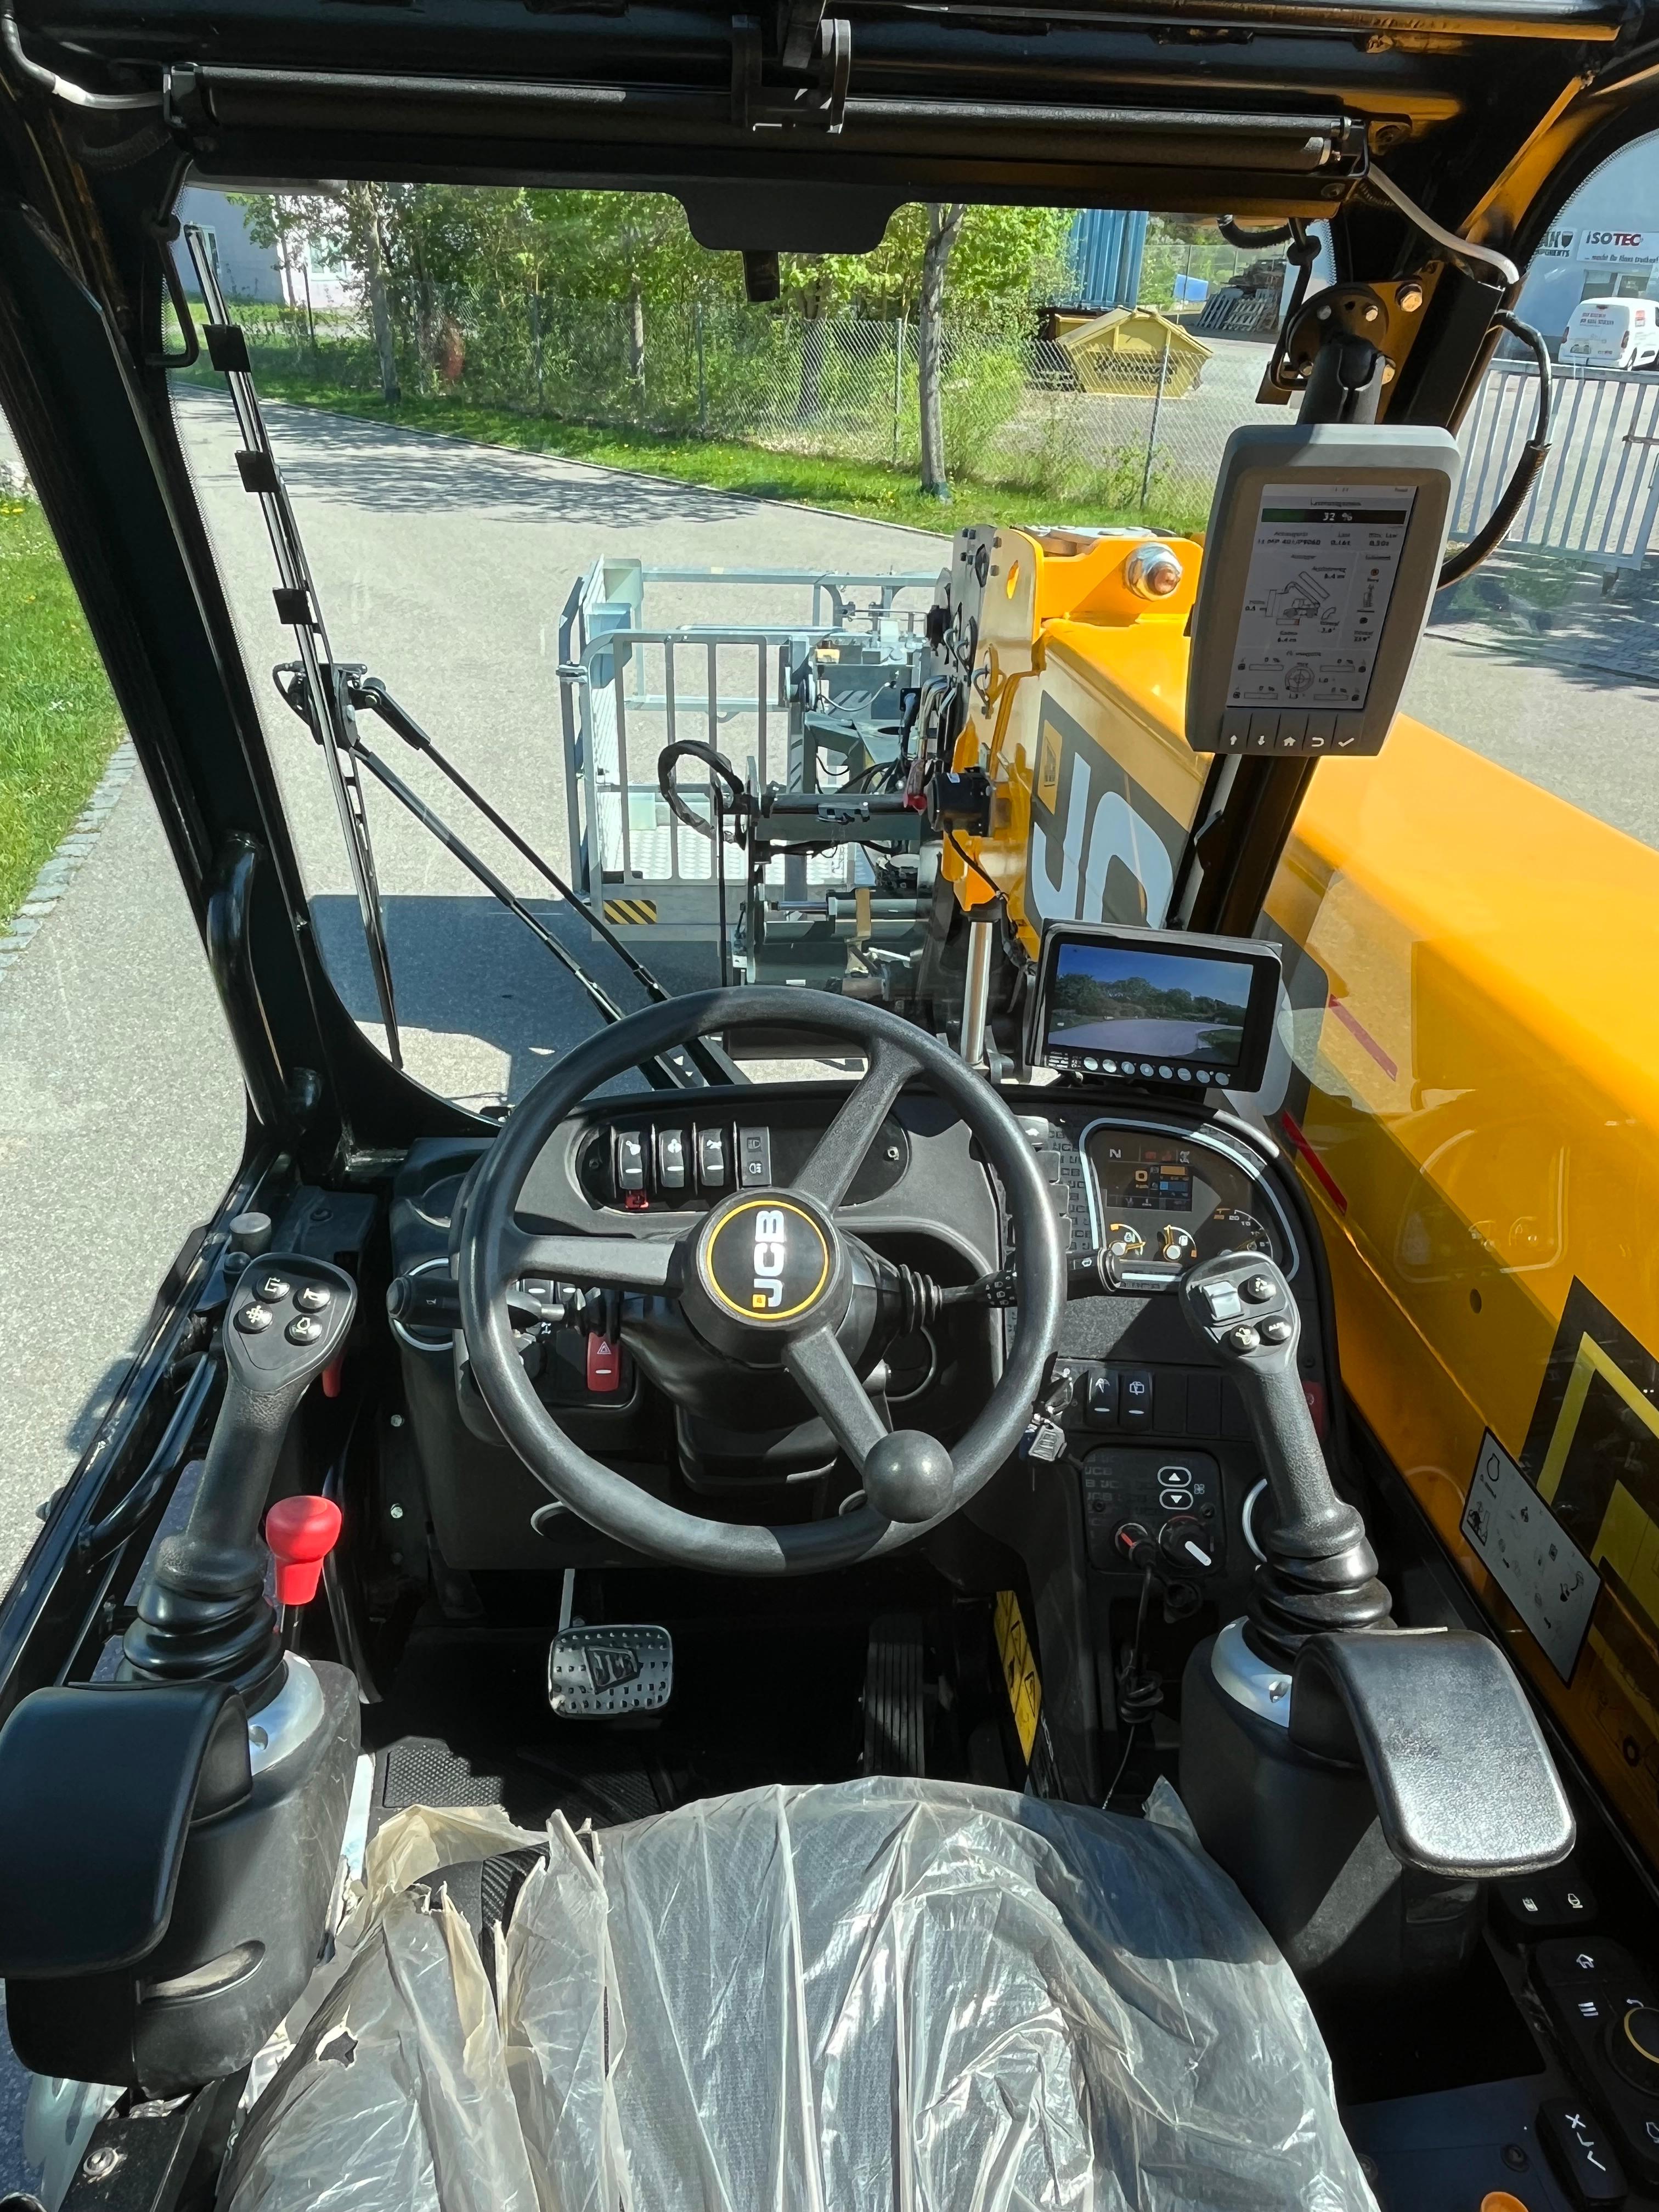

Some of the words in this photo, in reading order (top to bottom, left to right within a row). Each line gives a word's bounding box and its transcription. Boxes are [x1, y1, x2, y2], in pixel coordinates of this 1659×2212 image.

[1586, 231, 1641, 246] ISOTEC
[1109, 1148, 1121, 1159] N
[753, 1210, 785, 1307] JCB
